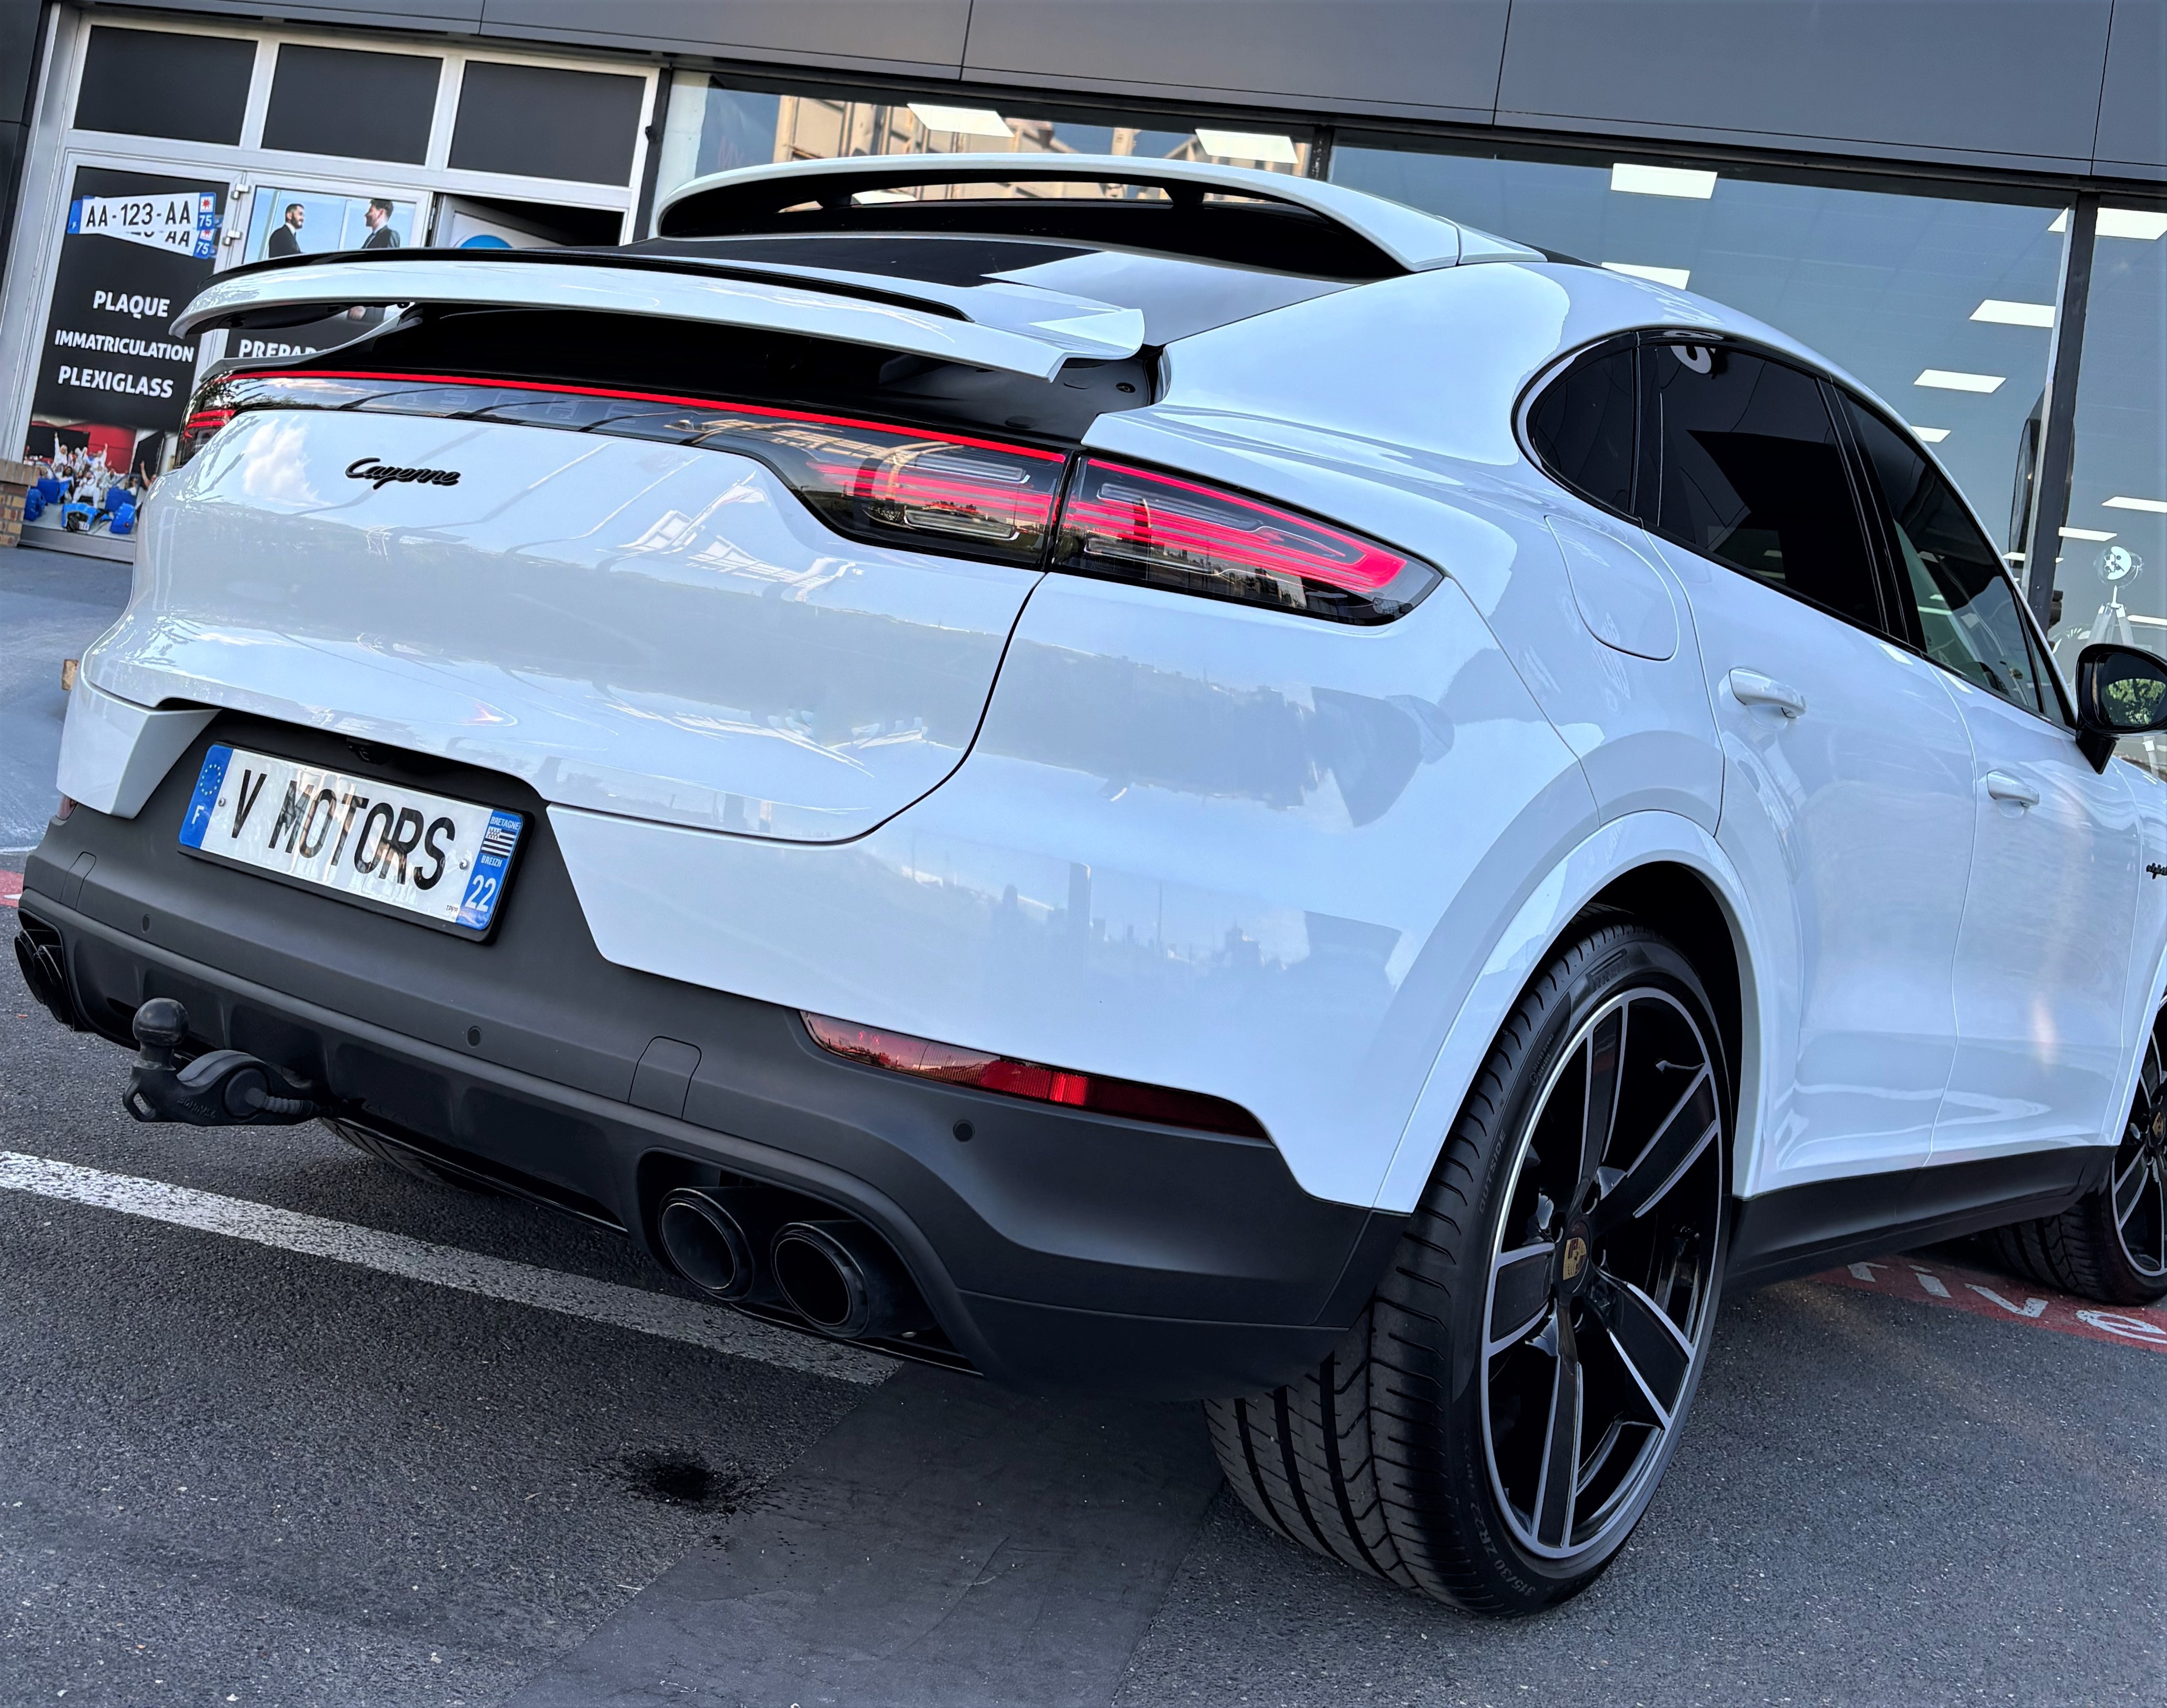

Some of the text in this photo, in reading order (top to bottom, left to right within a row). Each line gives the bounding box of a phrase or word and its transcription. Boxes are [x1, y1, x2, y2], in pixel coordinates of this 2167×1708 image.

[199, 214, 212, 227] 75
[197, 242, 209, 255] 75
[93, 290, 170, 319] PLAQUE
[55, 330, 194, 363] IMMATRICULATION
[58, 365, 174, 398] PLEXIGLASS
[345, 457, 461, 490] Cayenne
[191, 805, 204, 825] F
[232, 769, 455, 890] V MOTORS
[490, 816, 521, 830] BRETAGNE
[465, 874, 496, 912] 22
[1479, 1131, 1506, 1213] OUTSIDE
